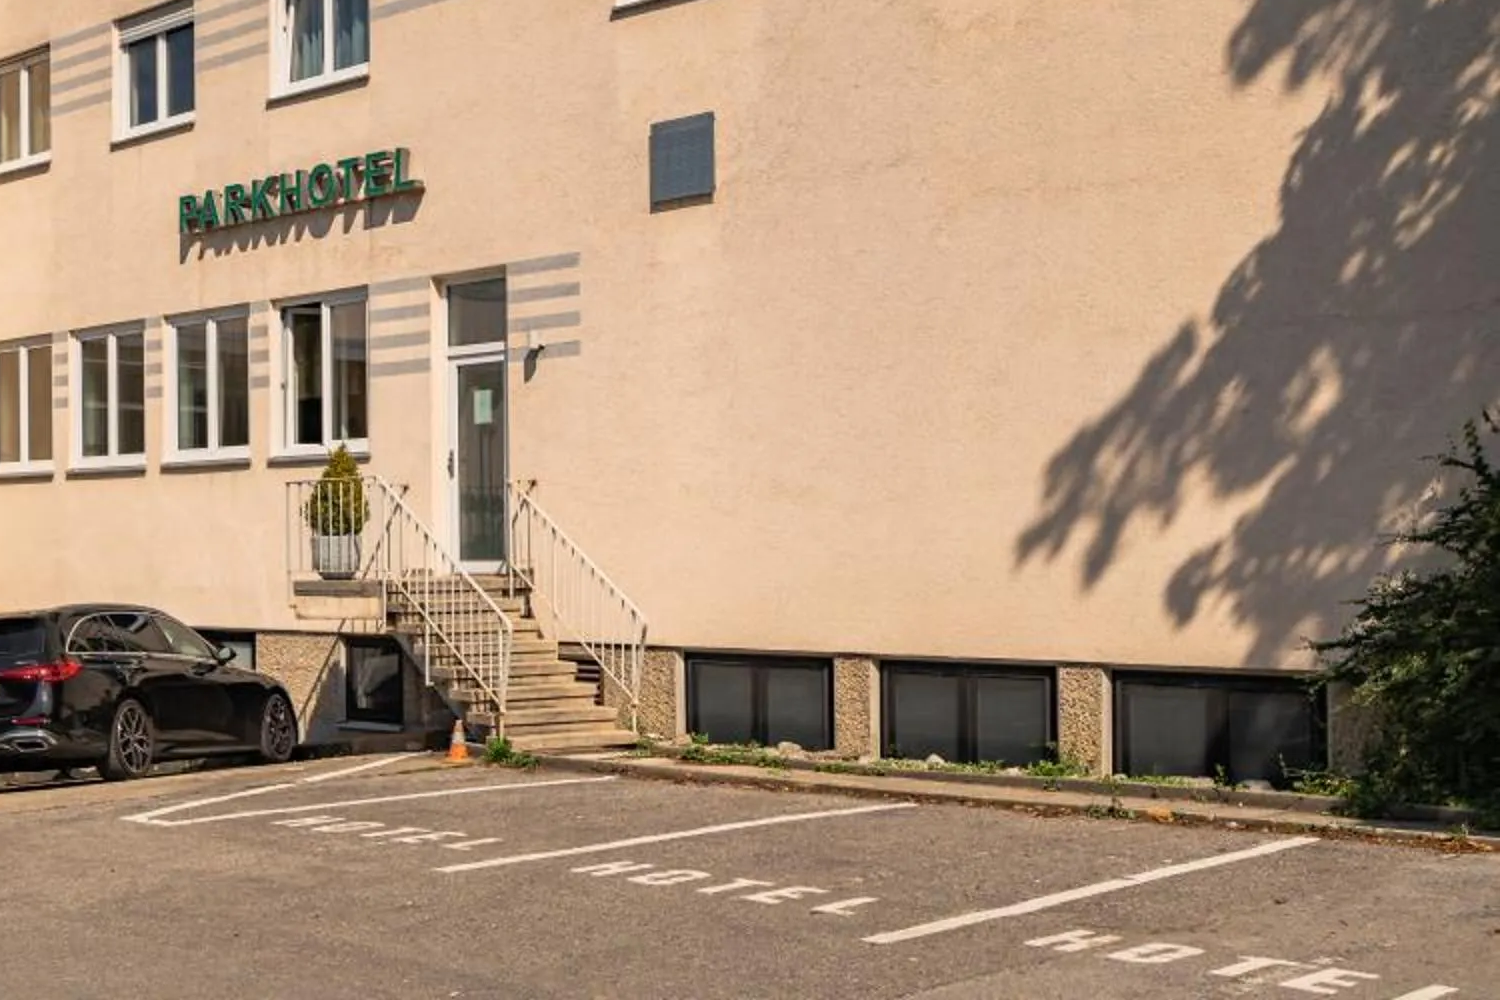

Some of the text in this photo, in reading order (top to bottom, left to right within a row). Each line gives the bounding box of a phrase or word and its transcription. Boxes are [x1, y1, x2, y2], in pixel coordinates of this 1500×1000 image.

[179, 147, 422, 235] PARKHOTEL
[270, 815, 502, 850] HOTEL
[570, 860, 880, 916] HOTEL
